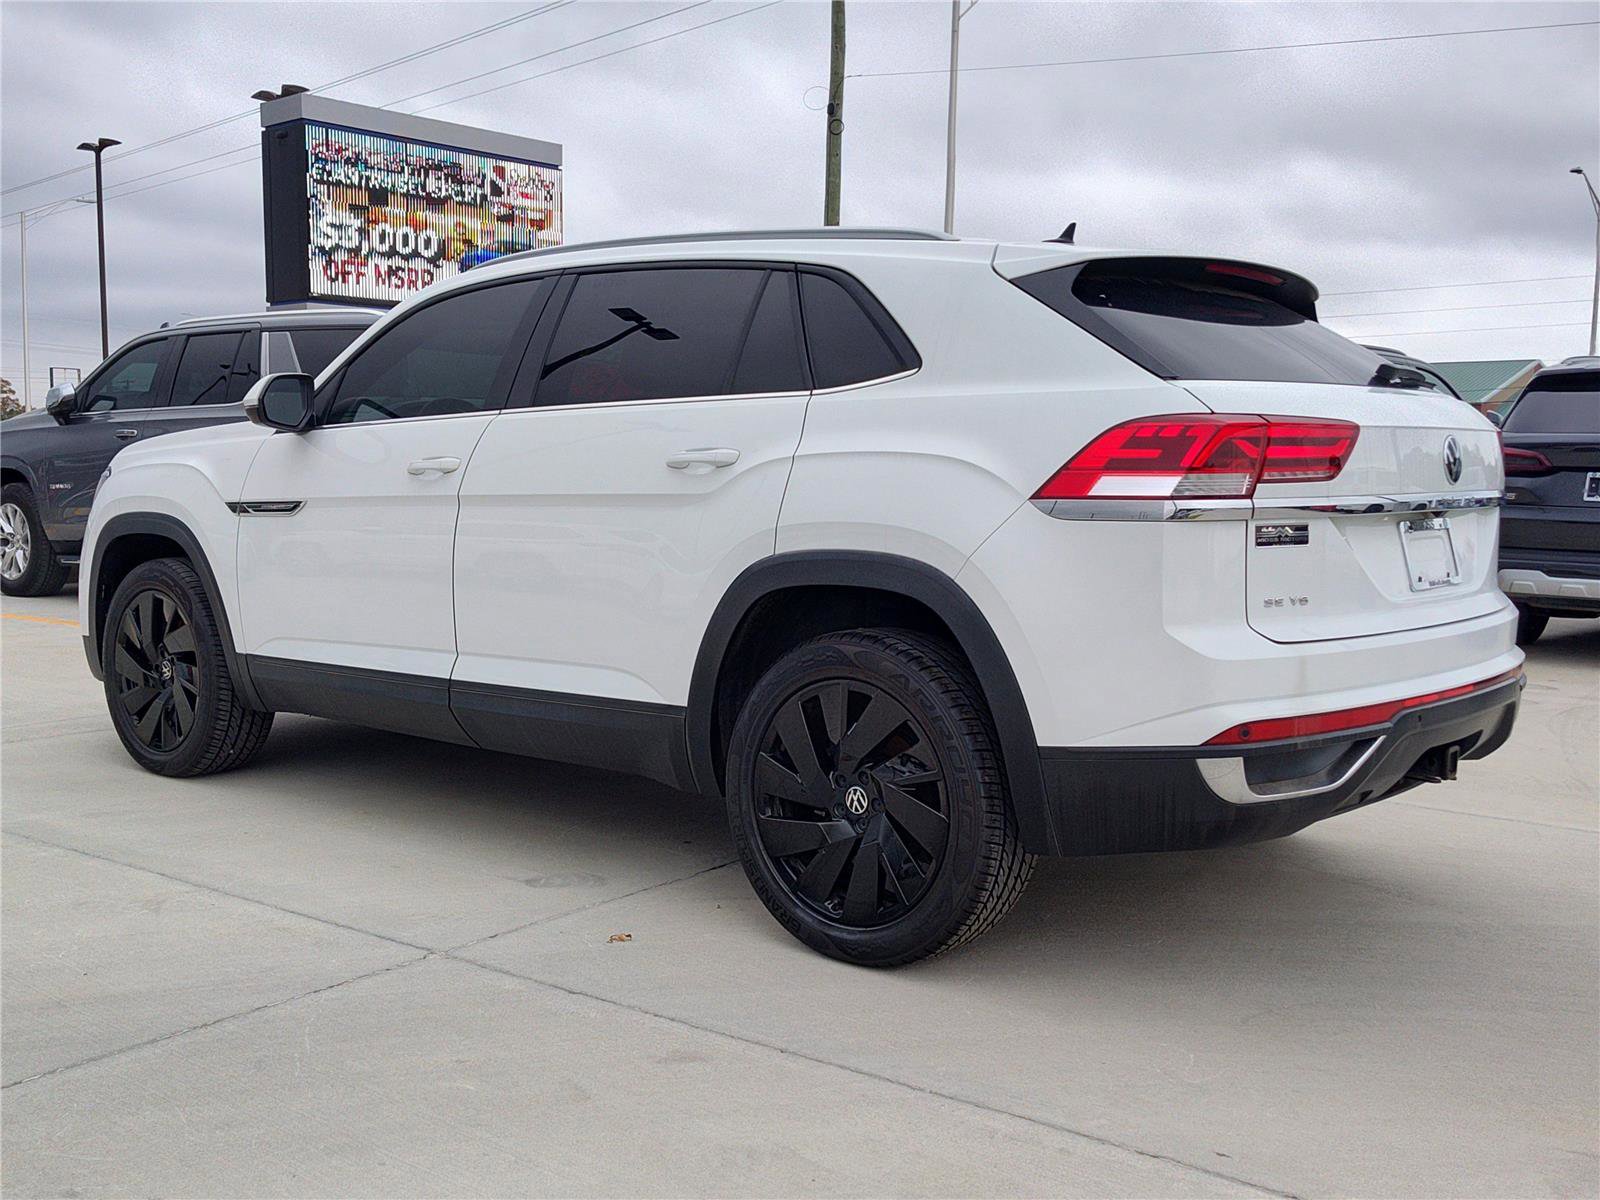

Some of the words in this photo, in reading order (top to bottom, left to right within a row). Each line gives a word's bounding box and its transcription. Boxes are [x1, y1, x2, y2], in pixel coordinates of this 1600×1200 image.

[322, 257, 368, 285] OFF
[375, 263, 434, 291] MSRP
[1264, 597, 1284, 608] SE
[1289, 596, 1309, 606] V6
